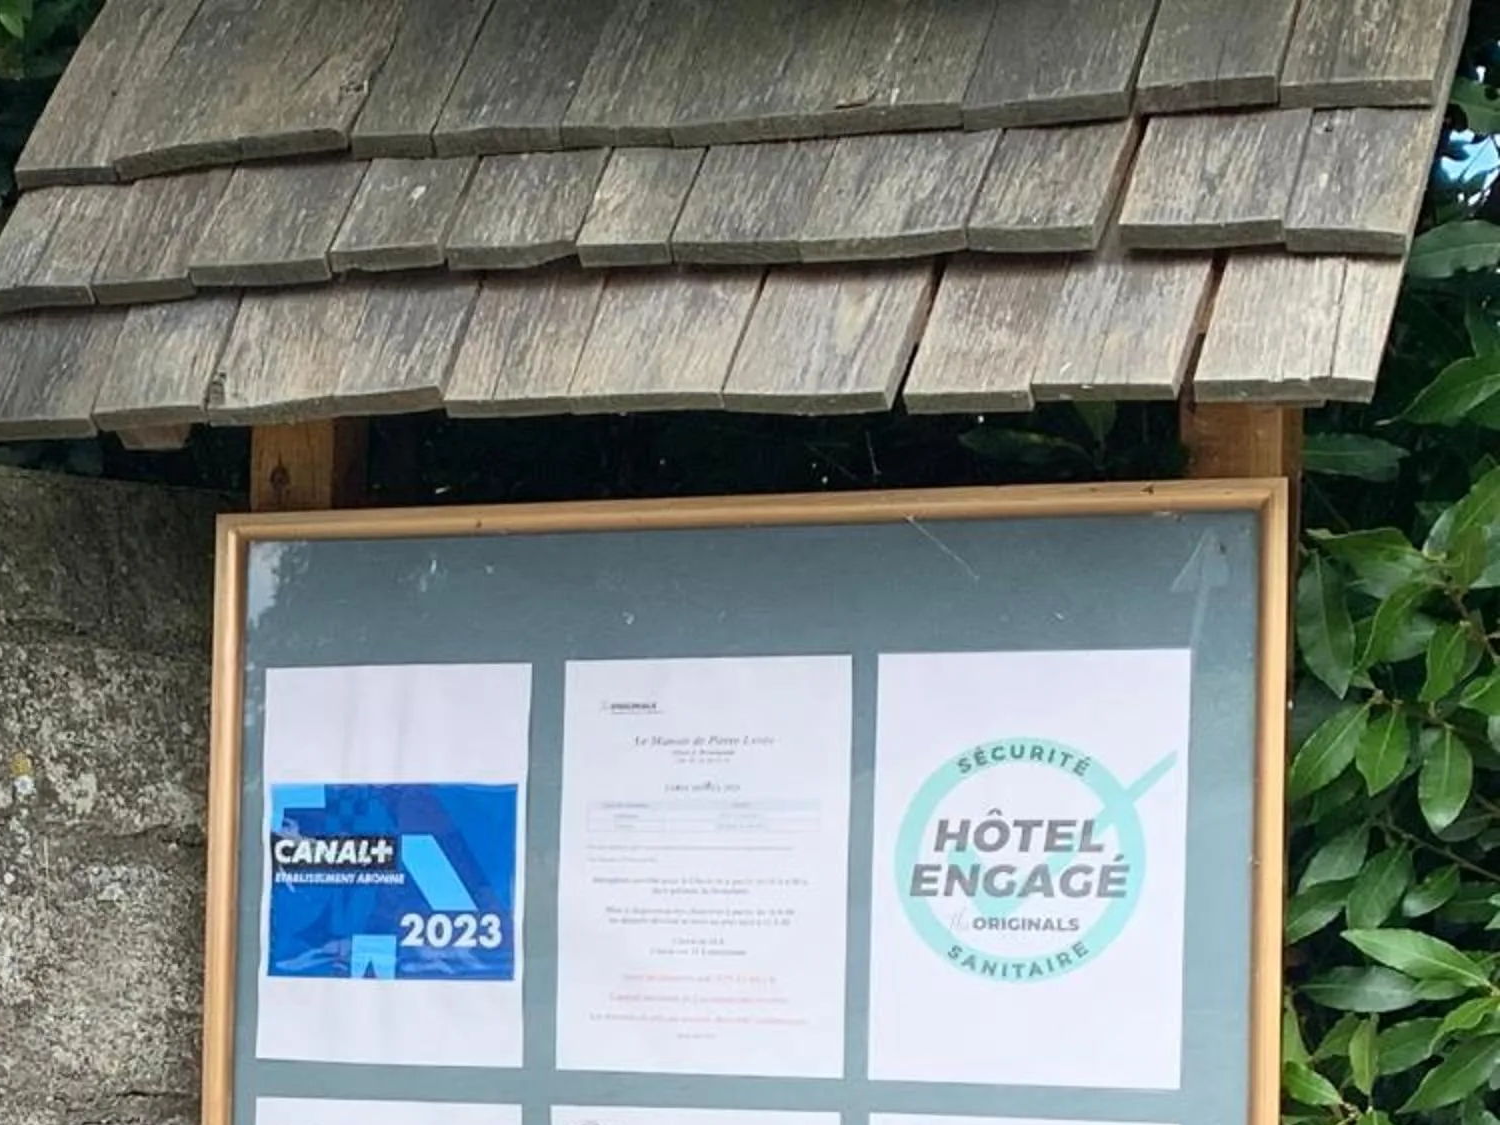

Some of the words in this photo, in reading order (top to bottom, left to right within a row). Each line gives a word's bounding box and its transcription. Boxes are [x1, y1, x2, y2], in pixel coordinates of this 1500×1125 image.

[956, 744, 1092, 777] SÉCURITÉ
[933, 807, 1105, 853] HÔTEL
[274, 839, 393, 864] CANAL+
[909, 854, 1130, 898] ENGAGÉ
[400, 913, 502, 948] 2023
[973, 917, 1080, 932] ORIGINALS
[947, 941, 1089, 980] SANITAIRE
